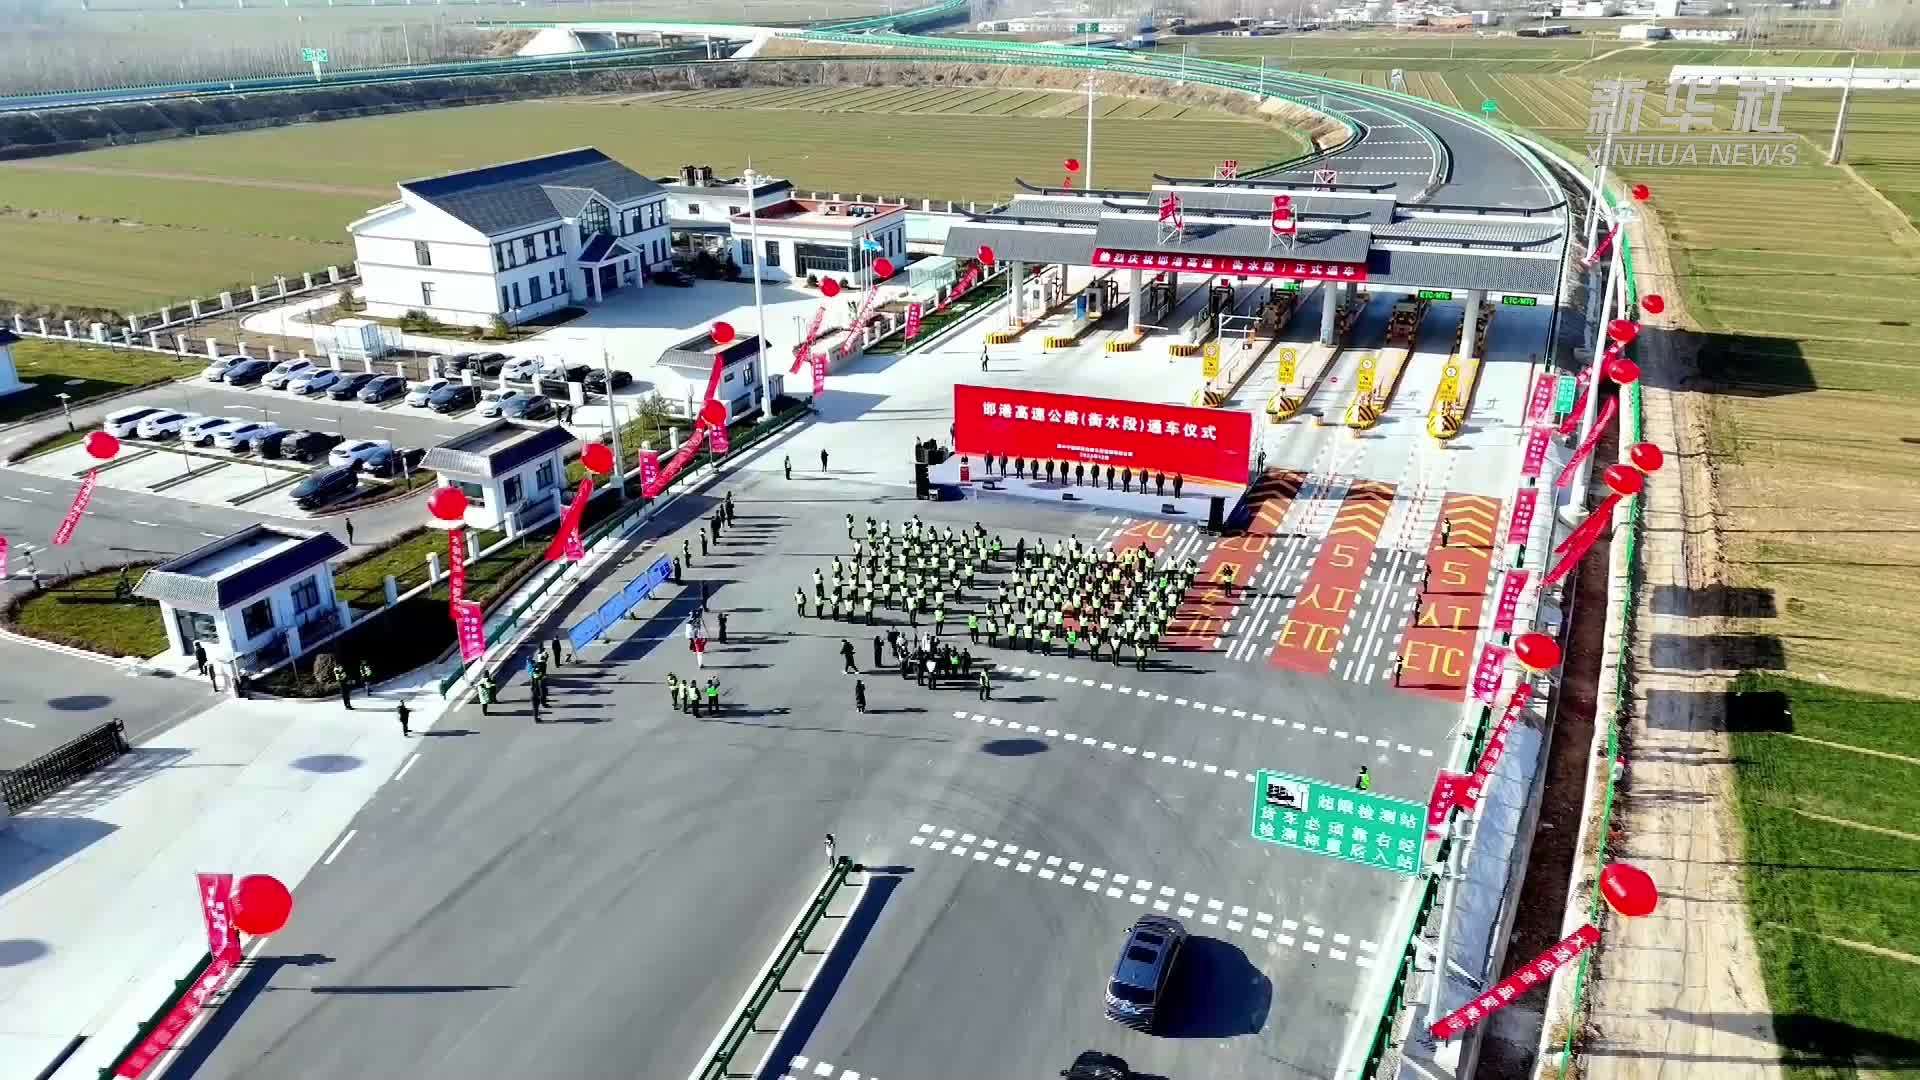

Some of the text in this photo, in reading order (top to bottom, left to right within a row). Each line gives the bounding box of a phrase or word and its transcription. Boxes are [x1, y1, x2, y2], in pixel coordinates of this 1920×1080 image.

[1329, 543, 1359, 568] 5
[1440, 560, 1472, 586] 5
[1279, 619, 1342, 654] ETC
[1403, 640, 1466, 677] ETC
